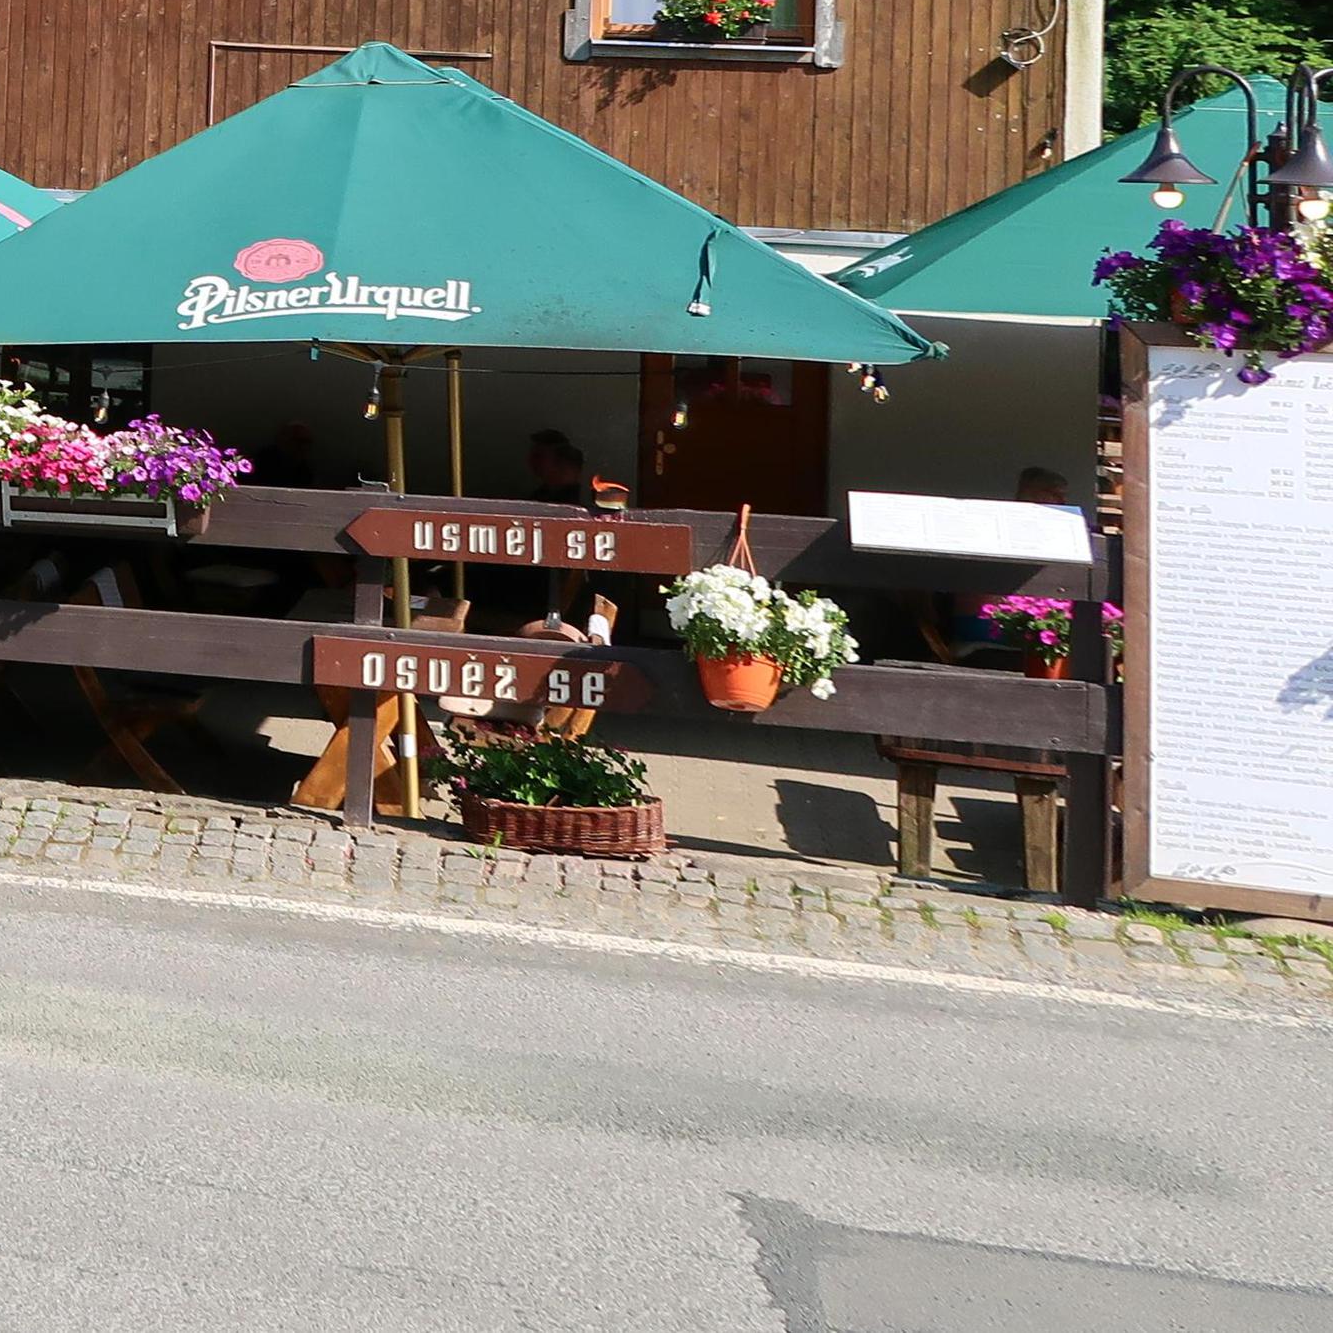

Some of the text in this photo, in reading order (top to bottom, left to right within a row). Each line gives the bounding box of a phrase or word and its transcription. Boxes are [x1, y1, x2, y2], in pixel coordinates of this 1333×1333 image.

[177, 275, 330, 330] Pilsner
[413, 520, 616, 565] usměj se
[362, 652, 606, 707] osvěž se
